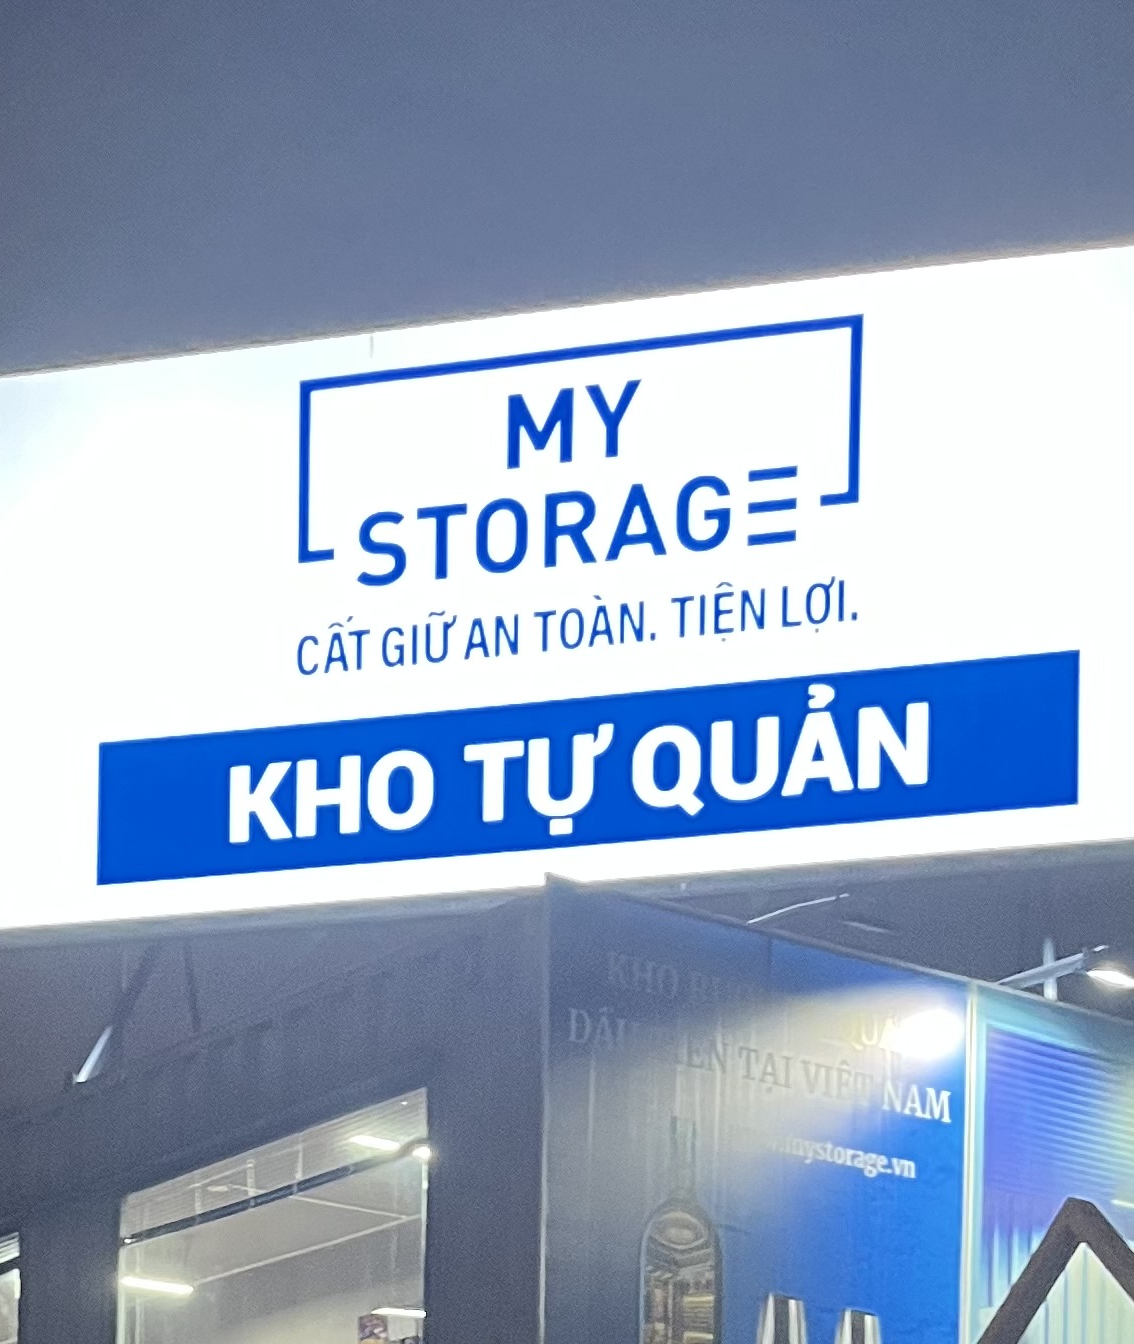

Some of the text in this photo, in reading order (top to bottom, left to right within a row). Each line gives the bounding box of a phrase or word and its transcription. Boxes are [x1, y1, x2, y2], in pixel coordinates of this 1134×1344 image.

[507, 379, 641, 469] MY
[357, 466, 798, 586] STORAGE
[296, 576, 859, 675] CẤT GIỮ AN TOÀN. TIỆN LỢI.
[228, 684, 931, 844] KHO TỰ QUẢN
[882, 1076, 953, 1123] NAM
